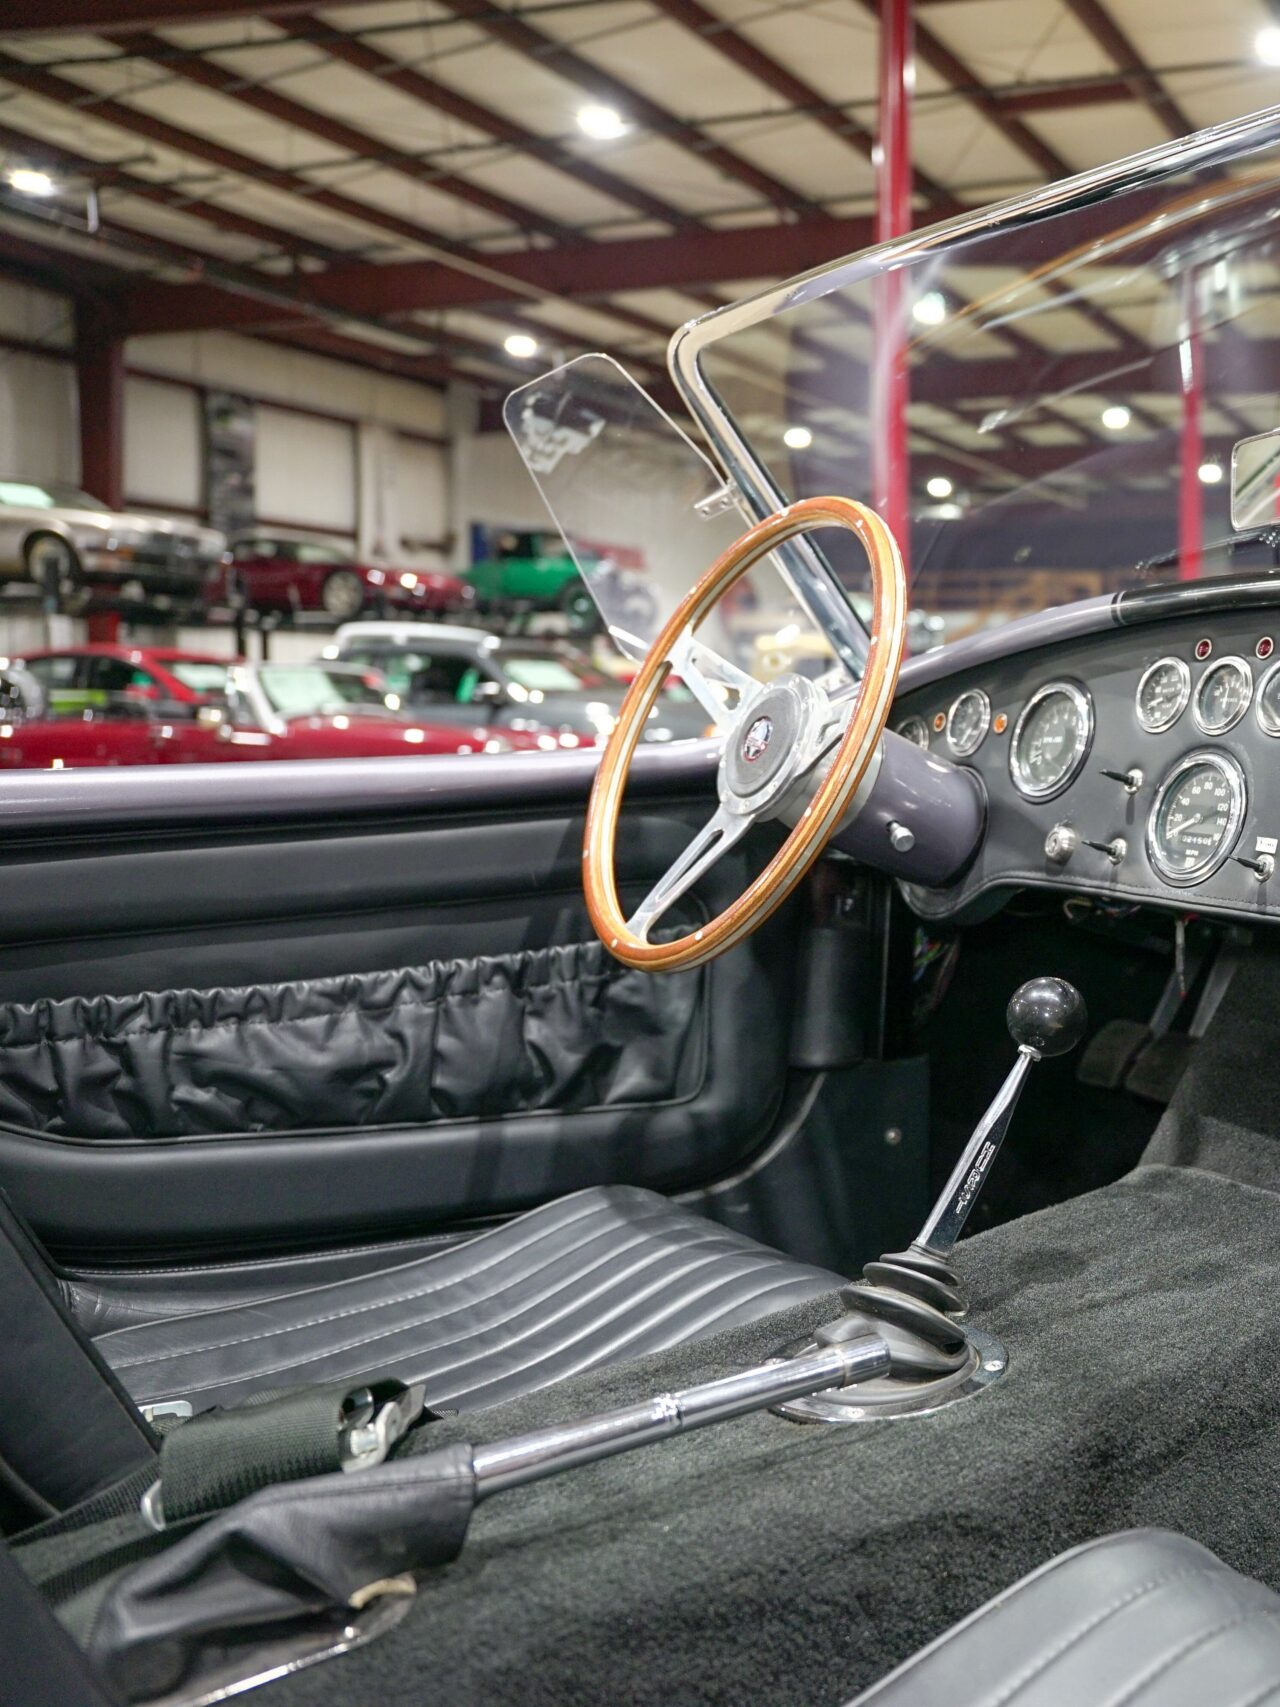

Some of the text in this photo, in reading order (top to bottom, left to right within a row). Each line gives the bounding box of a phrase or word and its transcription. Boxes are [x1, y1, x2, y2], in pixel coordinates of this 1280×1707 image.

[1192, 786, 1201, 794] 60
[1204, 782, 1213, 790] 80
[1214, 788, 1226, 796] 100
[1181, 798, 1190, 806] 40
[1218, 803, 1229, 811] 120
[1174, 813, 1183, 821] 20
[955, 1141, 996, 1214] HURST
